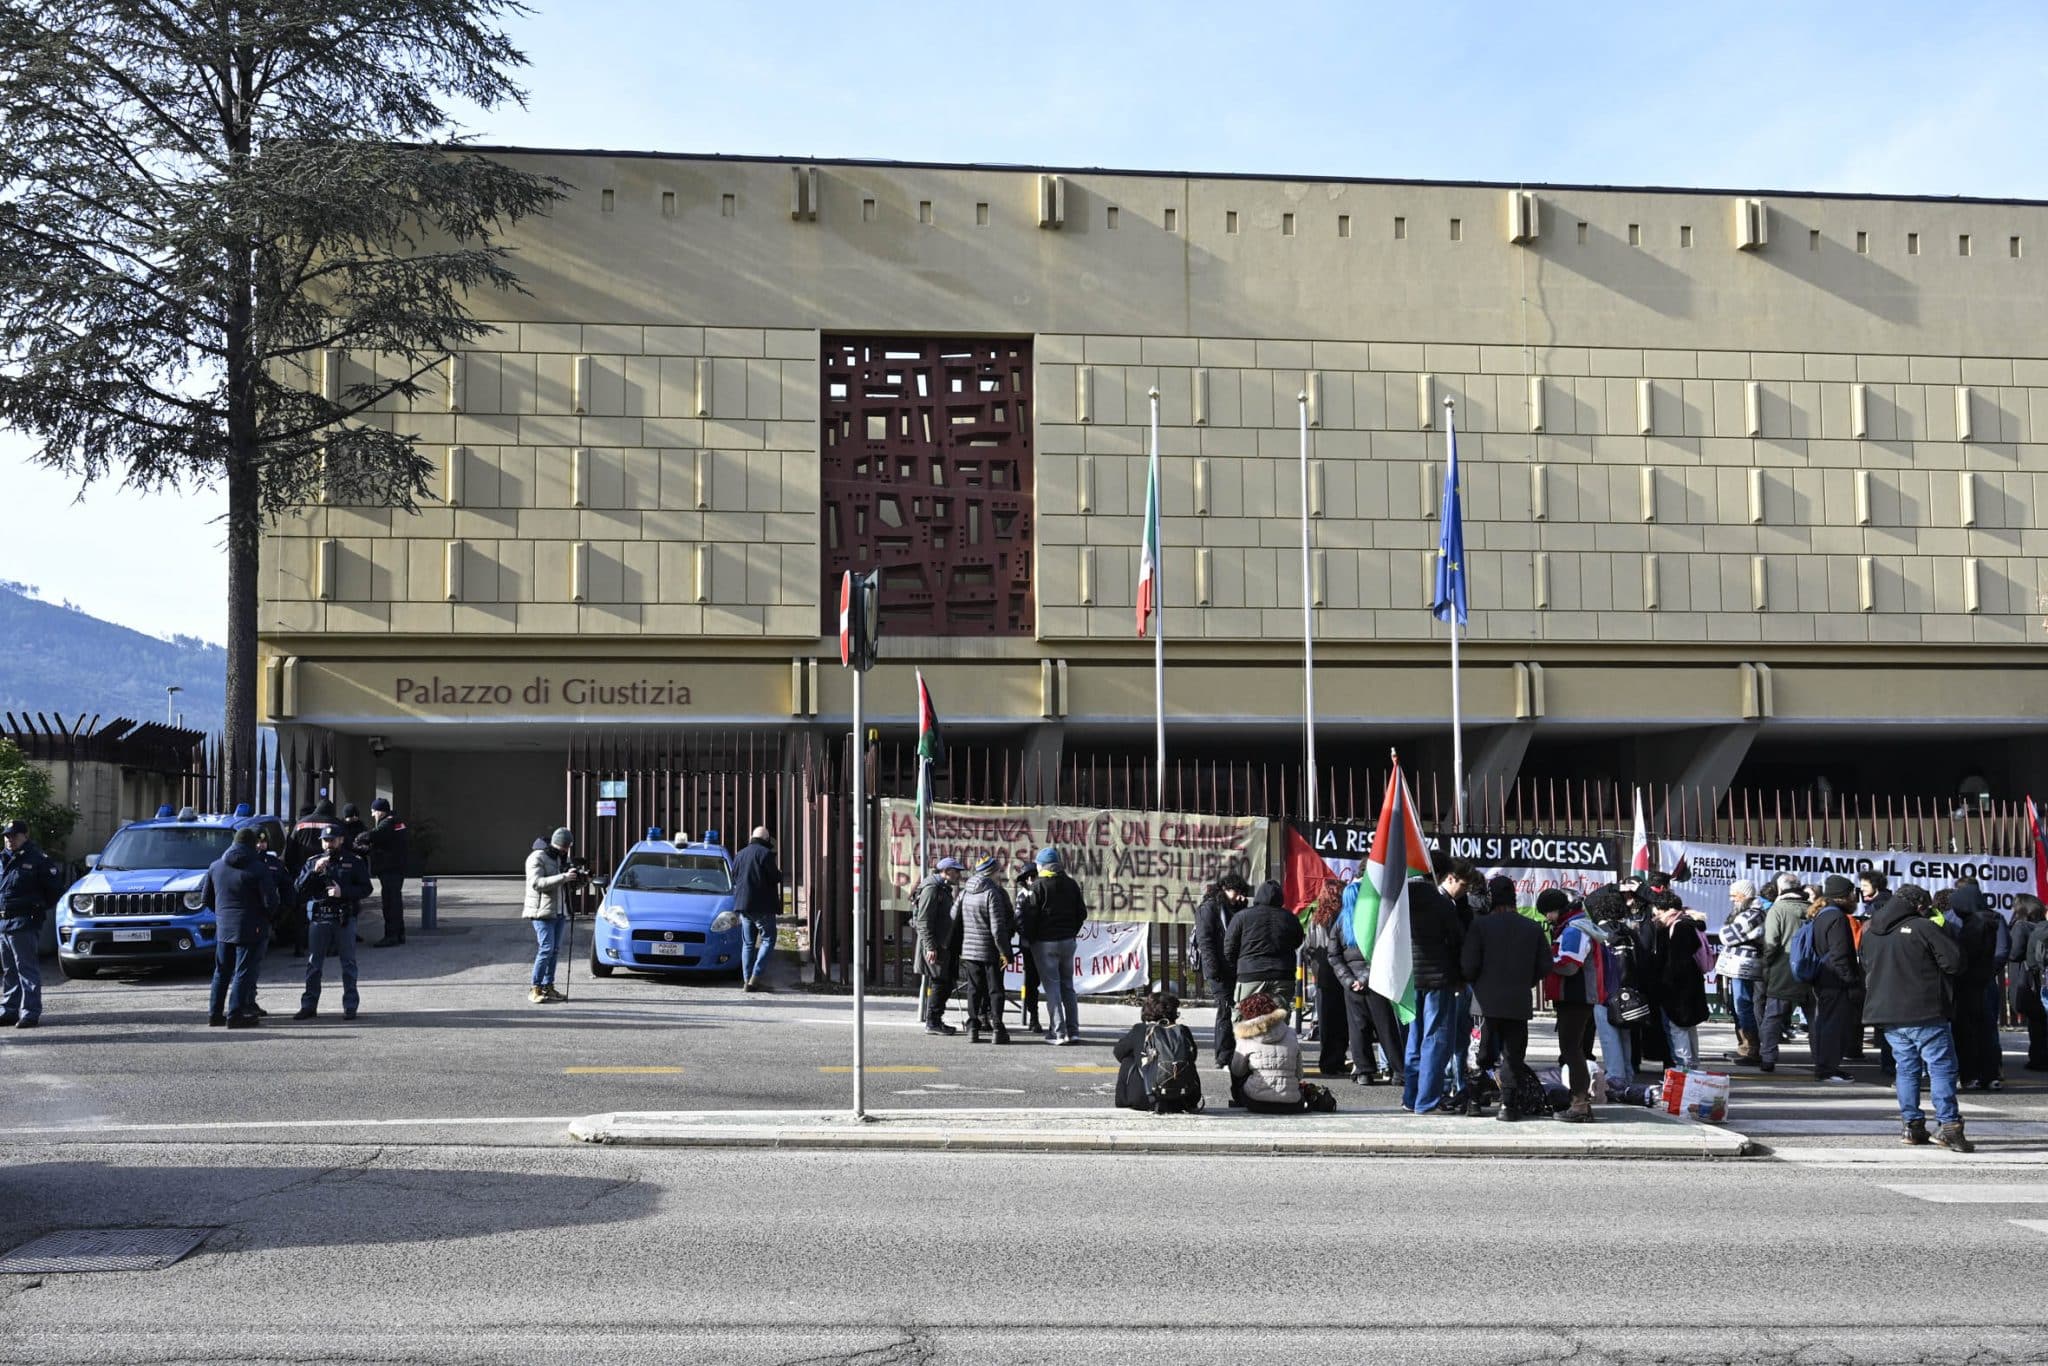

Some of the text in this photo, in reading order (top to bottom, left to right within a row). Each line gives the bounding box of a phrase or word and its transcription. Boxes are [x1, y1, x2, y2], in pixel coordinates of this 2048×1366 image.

[396, 676, 692, 705] Palazzo di Giustizia
[890, 811, 915, 837] LA
[1046, 818, 1089, 846] NON
[1121, 820, 1150, 847] UN
[890, 842, 911, 866] IL
[1060, 847, 1103, 877] NAN
[1113, 848, 1182, 880] YAEESH
[1315, 828, 1338, 850] LA
[1450, 837, 1482, 859] NON
[1486, 838, 1502, 860] SI
[1510, 838, 1608, 865] PROCESSA
[1692, 868, 1737, 879] FLOTILLA
[1693, 857, 1736, 868] FREEDOM
[1746, 852, 2028, 883] FERMIAMO IL GENOCIDIO
[1081, 883, 1197, 914] LIBERA
[1091, 951, 1140, 975] ANAN
